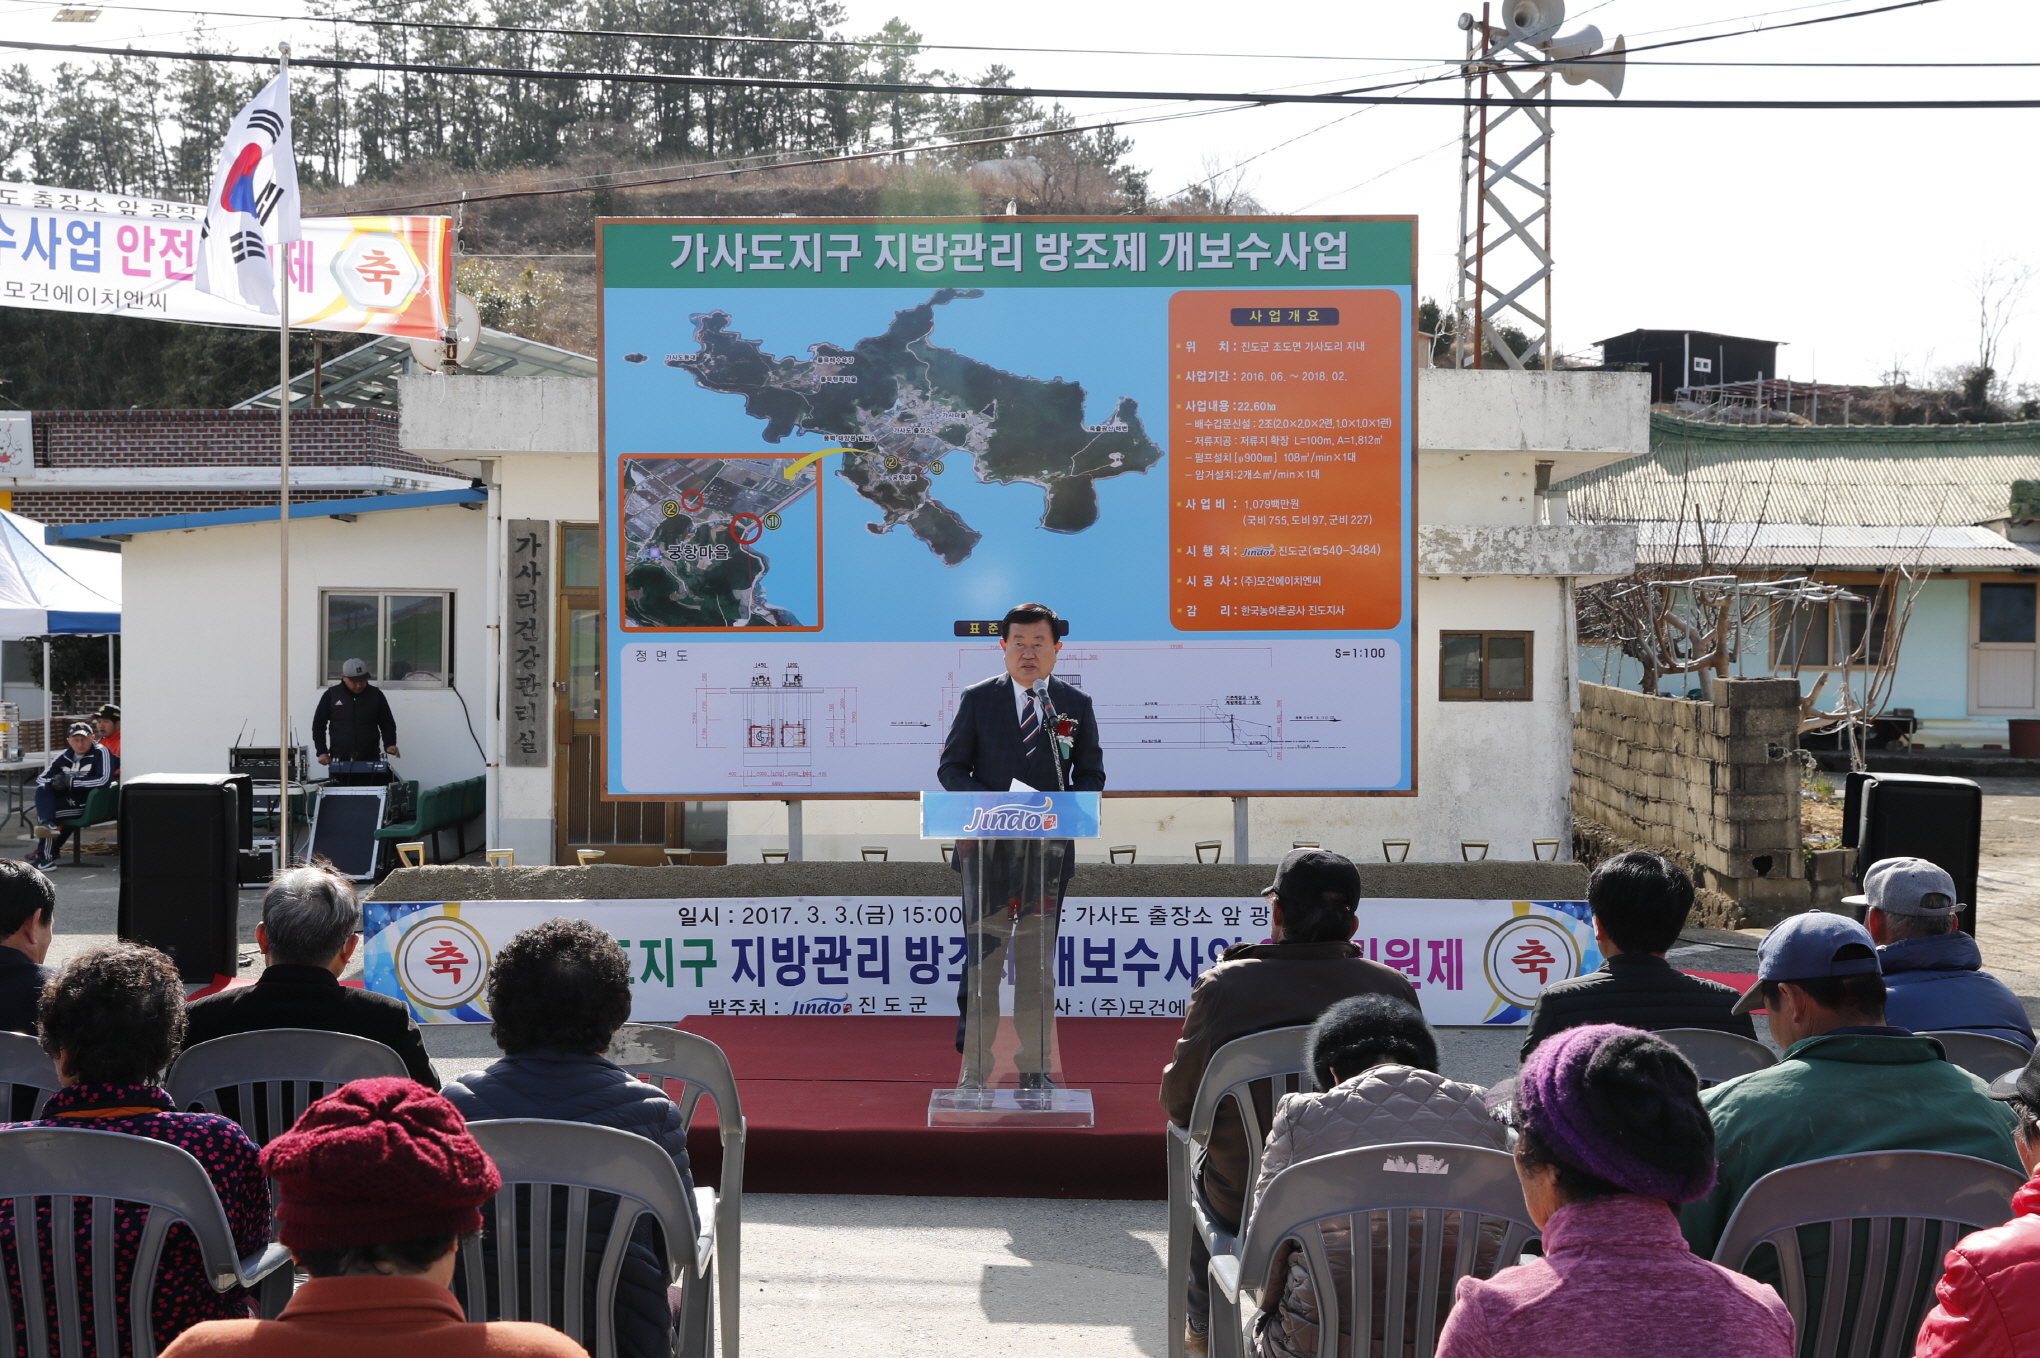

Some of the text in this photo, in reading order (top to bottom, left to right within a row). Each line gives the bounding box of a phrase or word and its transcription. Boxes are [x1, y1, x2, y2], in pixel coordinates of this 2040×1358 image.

[33, 190, 107, 214] 출장소
[117, 200, 140, 216] 앞
[150, 203, 199, 221] 광장
[670, 230, 1348, 273] 가사도지구 지방관리 방조제 개보수사업
[355, 249, 400, 296] 축
[1241, 341, 1270, 352] 진도군
[1273, 341, 1301, 352] 조도면
[1305, 341, 1343, 352] 가사도리
[1347, 341, 1365, 352] 지내
[1194, 418, 1251, 430] 배수갑문신설
[1194, 435, 1232, 446] 저류지공
[1240, 435, 1268, 446] 저류지
[1270, 435, 1289, 447] 확장
[668, 545, 729, 560] 궁항마을
[1240, 575, 1322, 587] (주)모건에이치엔씨
[1241, 604, 1305, 617] 한국농어촌공사
[1308, 604, 1345, 616] 진도지사
[969, 622, 999, 634] 표준
[515, 533, 542, 754] 가사리건강관리실
[1335, 648, 1386, 659] S=1:100
[678, 906, 719, 927] 일시
[742, 906, 799, 925] 2017.
[902, 906, 962, 924] 15:00
[1076, 905, 1140, 926] 가사도
[1148, 905, 1213, 927] 출장소
[1221, 906, 1241, 927] 앞
[1249, 906, 1271, 927] 광
[425, 940, 469, 985] 축
[618, 937, 718, 988] 지구
[731, 935, 890, 988] 지방관리
[1511, 939, 1556, 985] 축
[708, 999, 766, 1016] 발주처
[788, 1000, 841, 1016] Jindo
[1091, 997, 1186, 1017] (주)모건에
